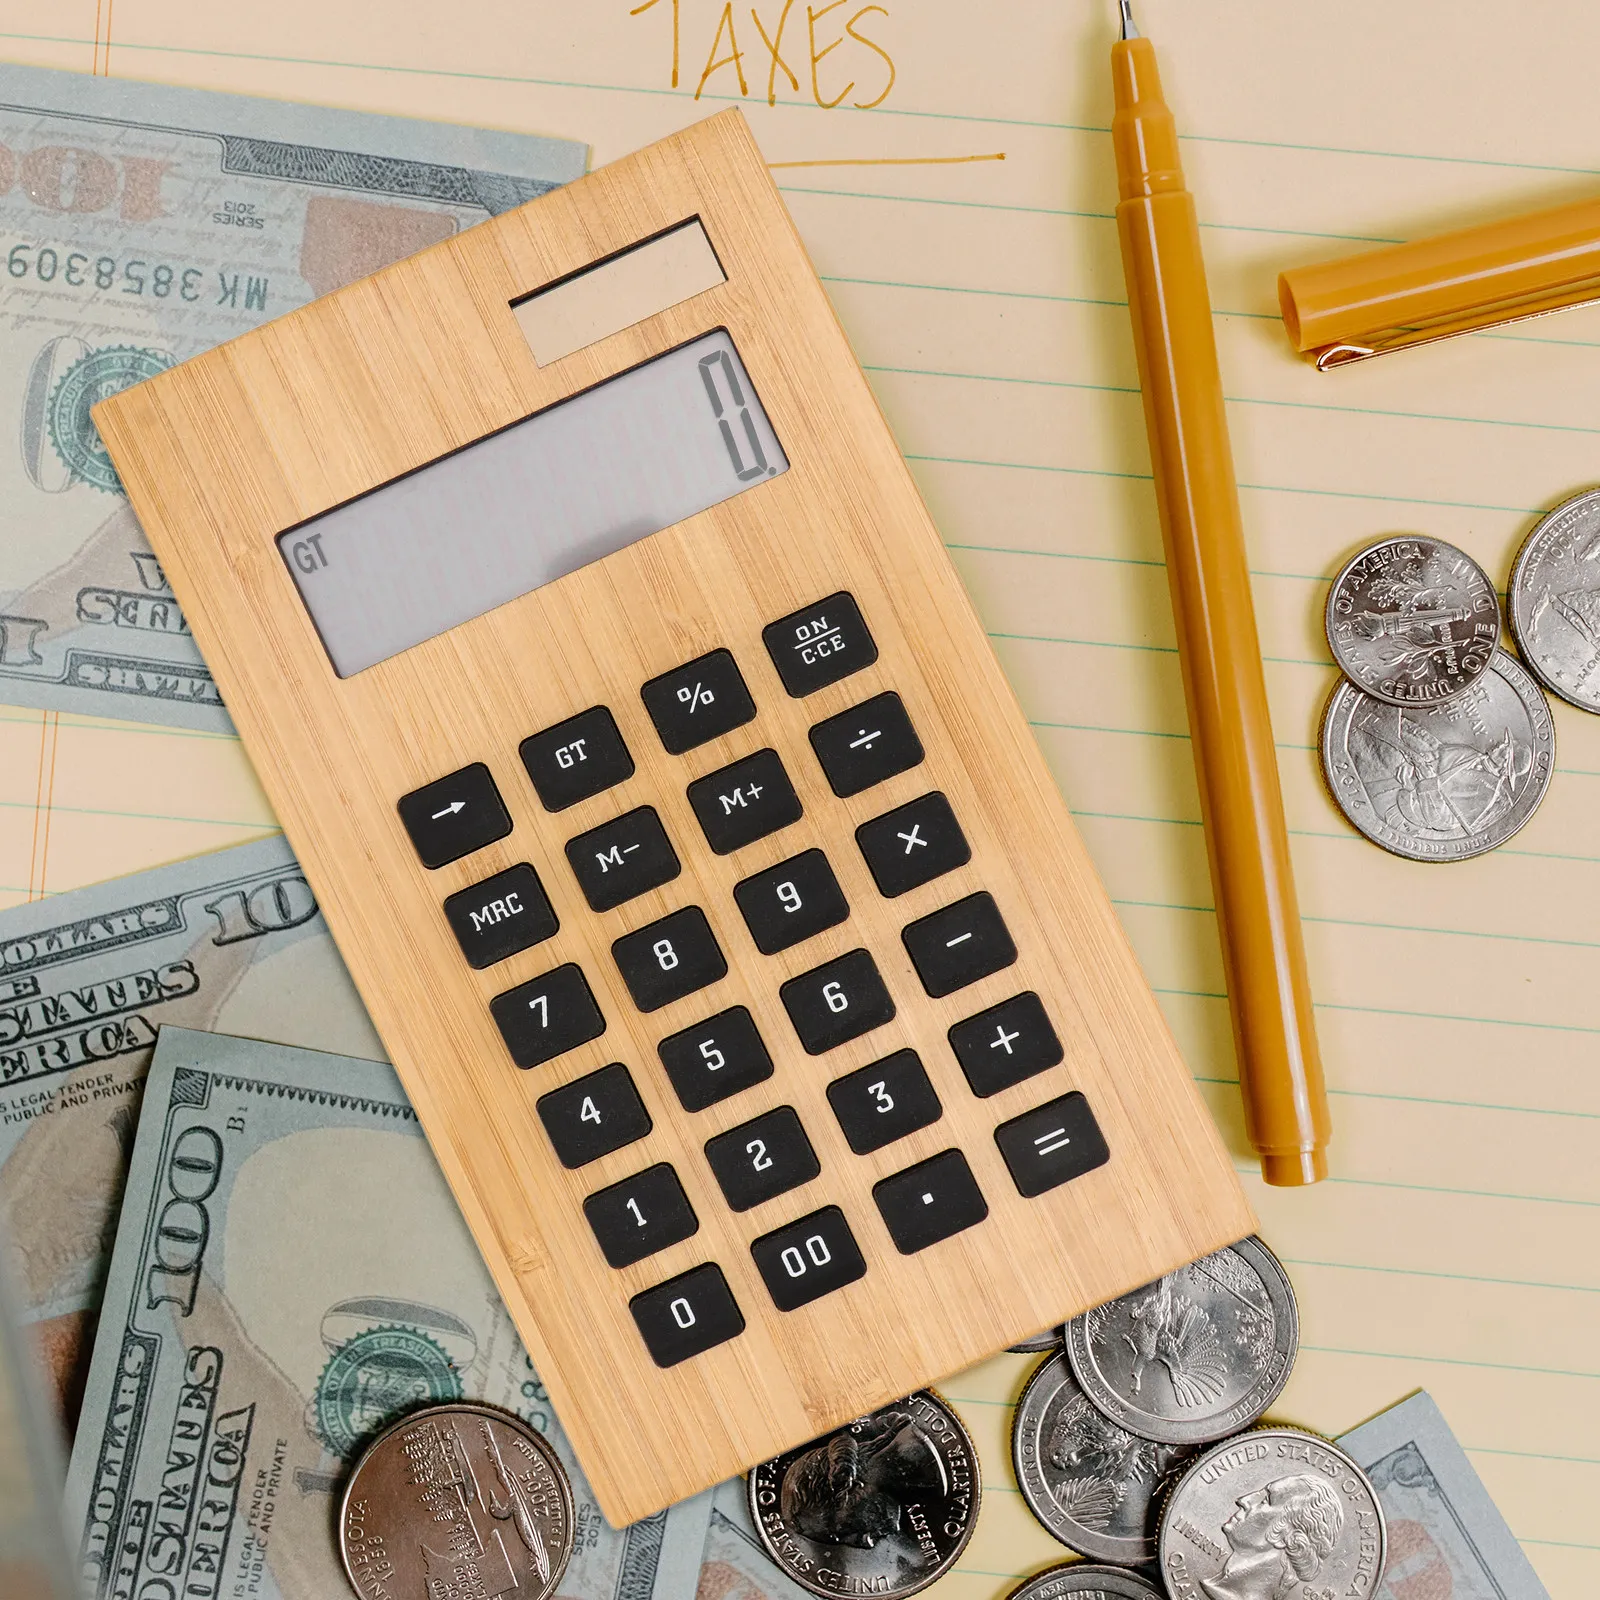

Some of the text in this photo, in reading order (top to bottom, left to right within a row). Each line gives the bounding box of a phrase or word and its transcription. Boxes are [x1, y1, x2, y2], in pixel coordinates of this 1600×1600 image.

[630, 0, 896, 109] TAXES
[0, 142, 175, 222] 10
[212, 212, 265, 230] SERIES
[223, 200, 256, 215] 2013
[215, 271, 269, 312] MK
[1538, 505, 1589, 550] PLURIBUS
[292, 532, 329, 574] GT
[1347, 543, 1425, 591] AMERICA
[1335, 588, 1356, 614] OF
[1450, 558, 1495, 614] DIME
[72, 585, 193, 635] TES
[795, 616, 829, 641] ON
[1335, 619, 1379, 685] STATES
[1461, 622, 1497, 675] ONE
[1380, 678, 1454, 701] UNITED
[1493, 655, 1550, 742] MBERLAND
[1458, 692, 1488, 736] RWAY
[554, 738, 588, 769] GT
[718, 782, 764, 816] M+
[1334, 761, 1366, 810] 2016
[203, 875, 320, 948] 10
[469, 892, 524, 932] MRC
[776, 881, 803, 913] 9
[0, 904, 172, 968] OLLARS
[652, 939, 679, 971] 8
[528, 995, 548, 1028] 7
[822, 981, 849, 1013] 6
[0, 1014, 158, 1088] ERICA
[698, 1038, 726, 1071] 5
[3, 1076, 147, 1126] PUBLIC AND PRIVAT
[10, 1089, 56, 1112] LEGAL
[58, 1072, 115, 1097] TENDER
[580, 1096, 602, 1125] 4
[867, 1080, 895, 1114] 3
[745, 1139, 774, 1172] 2
[146, 1125, 224, 1318] 100
[626, 1197, 648, 1227] 1
[780, 1234, 832, 1278] 00
[670, 1297, 696, 1329] 0
[145, 1345, 224, 1578] STATES
[512, 1437, 546, 1472] UNUM
[908, 1393, 970, 1538] QUARTER DOLLA
[1200, 1443, 1269, 1485] UNITED
[1277, 1442, 1343, 1478] STATES
[183, 1401, 256, 1600] ERICA
[519, 1469, 549, 1517] 2005
[541, 1474, 562, 1536] PLURIBUS
[1341, 1479, 1367, 1503] OF
[236, 1531, 257, 1583] LEGAL
[247, 1468, 268, 1531] TENDER
[247, 1437, 289, 1594] PUBLIC AND PRIVATE
[572, 1502, 591, 1556] SERIES
[586, 1515, 602, 1548] 2013
[758, 1479, 892, 1594] UNITED STATES OF
[906, 1503, 941, 1567] LIBERTY
[1046, 1505, 1066, 1528] EL
[347, 1499, 391, 1600] NNESOTA
[1171, 1515, 1230, 1563] LIBERTY
[1344, 1509, 1377, 1598] AMERICA
[453, 1564, 475, 1600] 0,000
[465, 1561, 488, 1599] LAKES
[1040, 1580, 1066, 1599] NEW
[1167, 1551, 1200, 1600] QUAR
